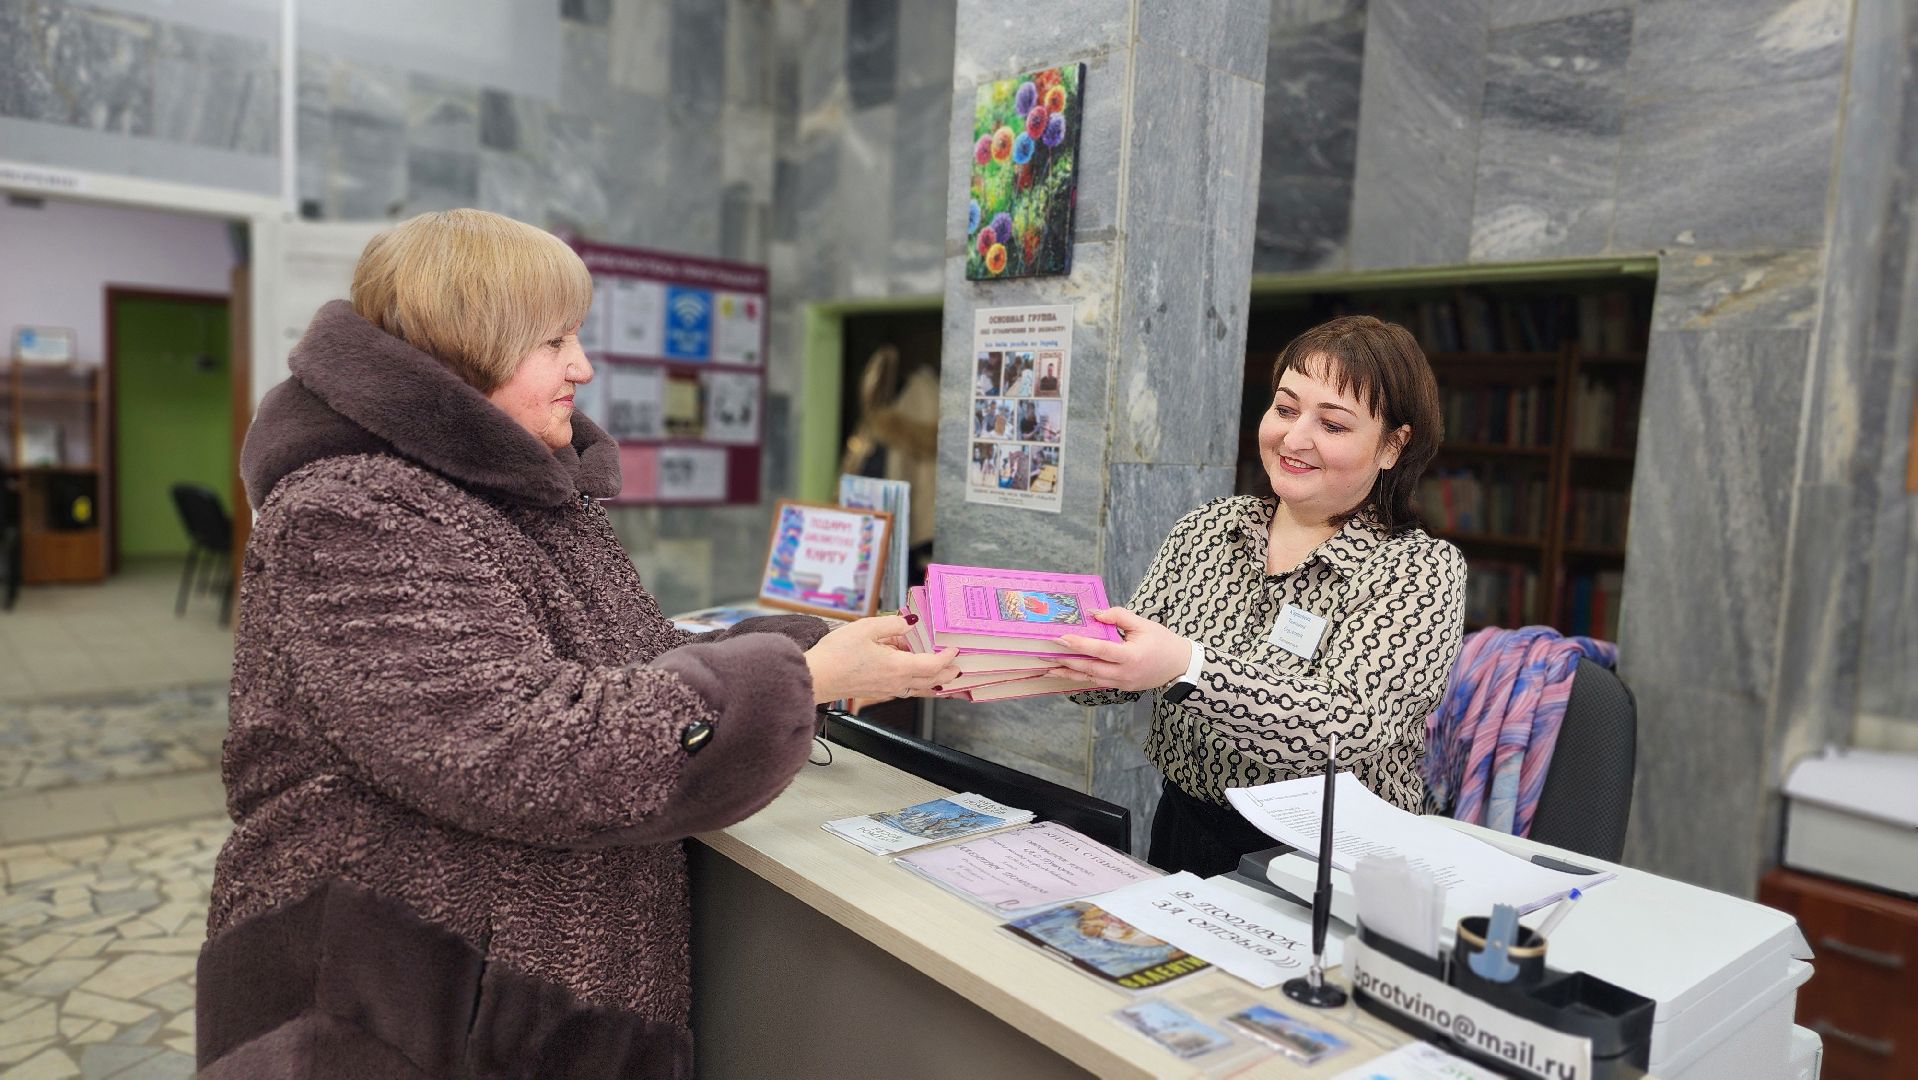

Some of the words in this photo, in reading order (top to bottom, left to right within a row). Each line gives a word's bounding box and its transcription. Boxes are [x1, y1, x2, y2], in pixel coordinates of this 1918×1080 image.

[1029, 313, 1057, 322] ГРУППА
[1152, 900, 1185, 915] ЗА
[1176, 890, 1194, 899] В
[1194, 902, 1306, 951] ПОДАРОК
